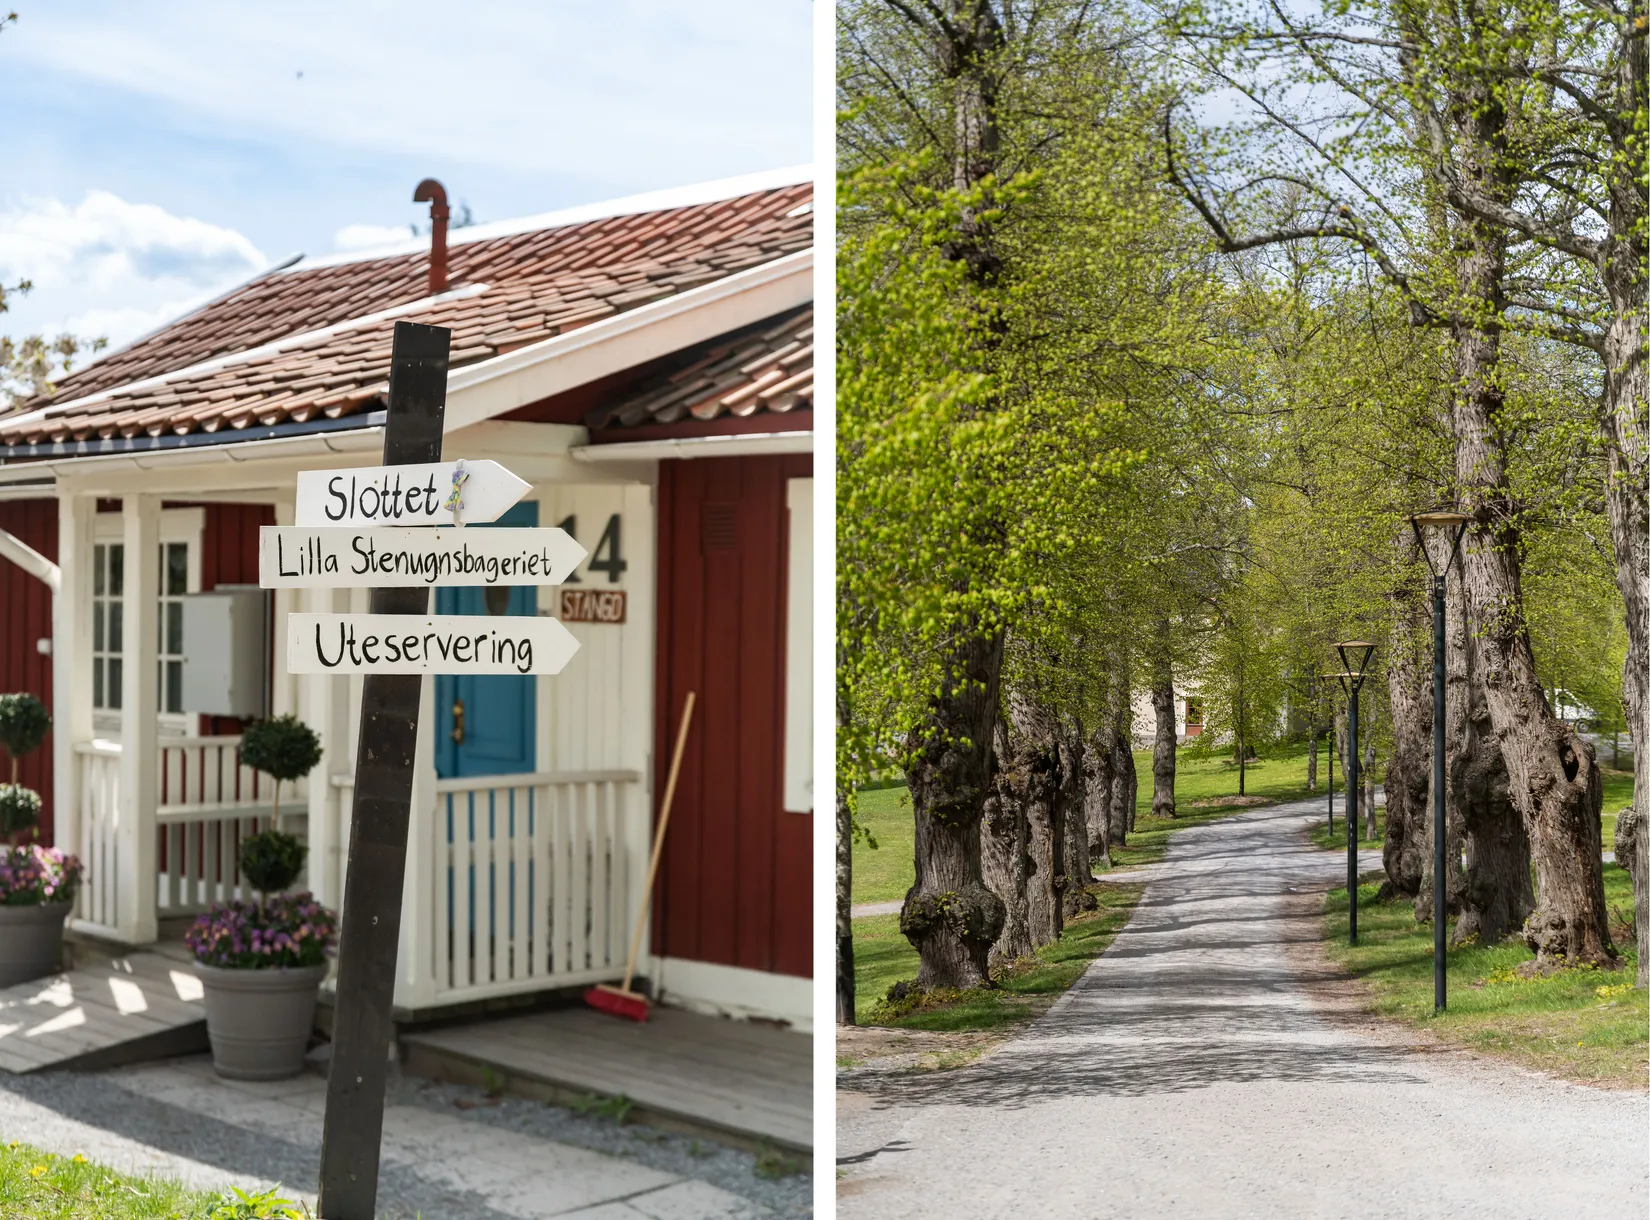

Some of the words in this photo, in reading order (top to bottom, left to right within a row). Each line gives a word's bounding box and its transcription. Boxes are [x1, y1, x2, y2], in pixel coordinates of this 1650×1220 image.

[325, 472, 439, 521] Slottet
[278, 533, 339, 577] Lilla
[351, 535, 553, 583] Stenugnsbageriet
[315, 622, 533, 673] Uteservering
